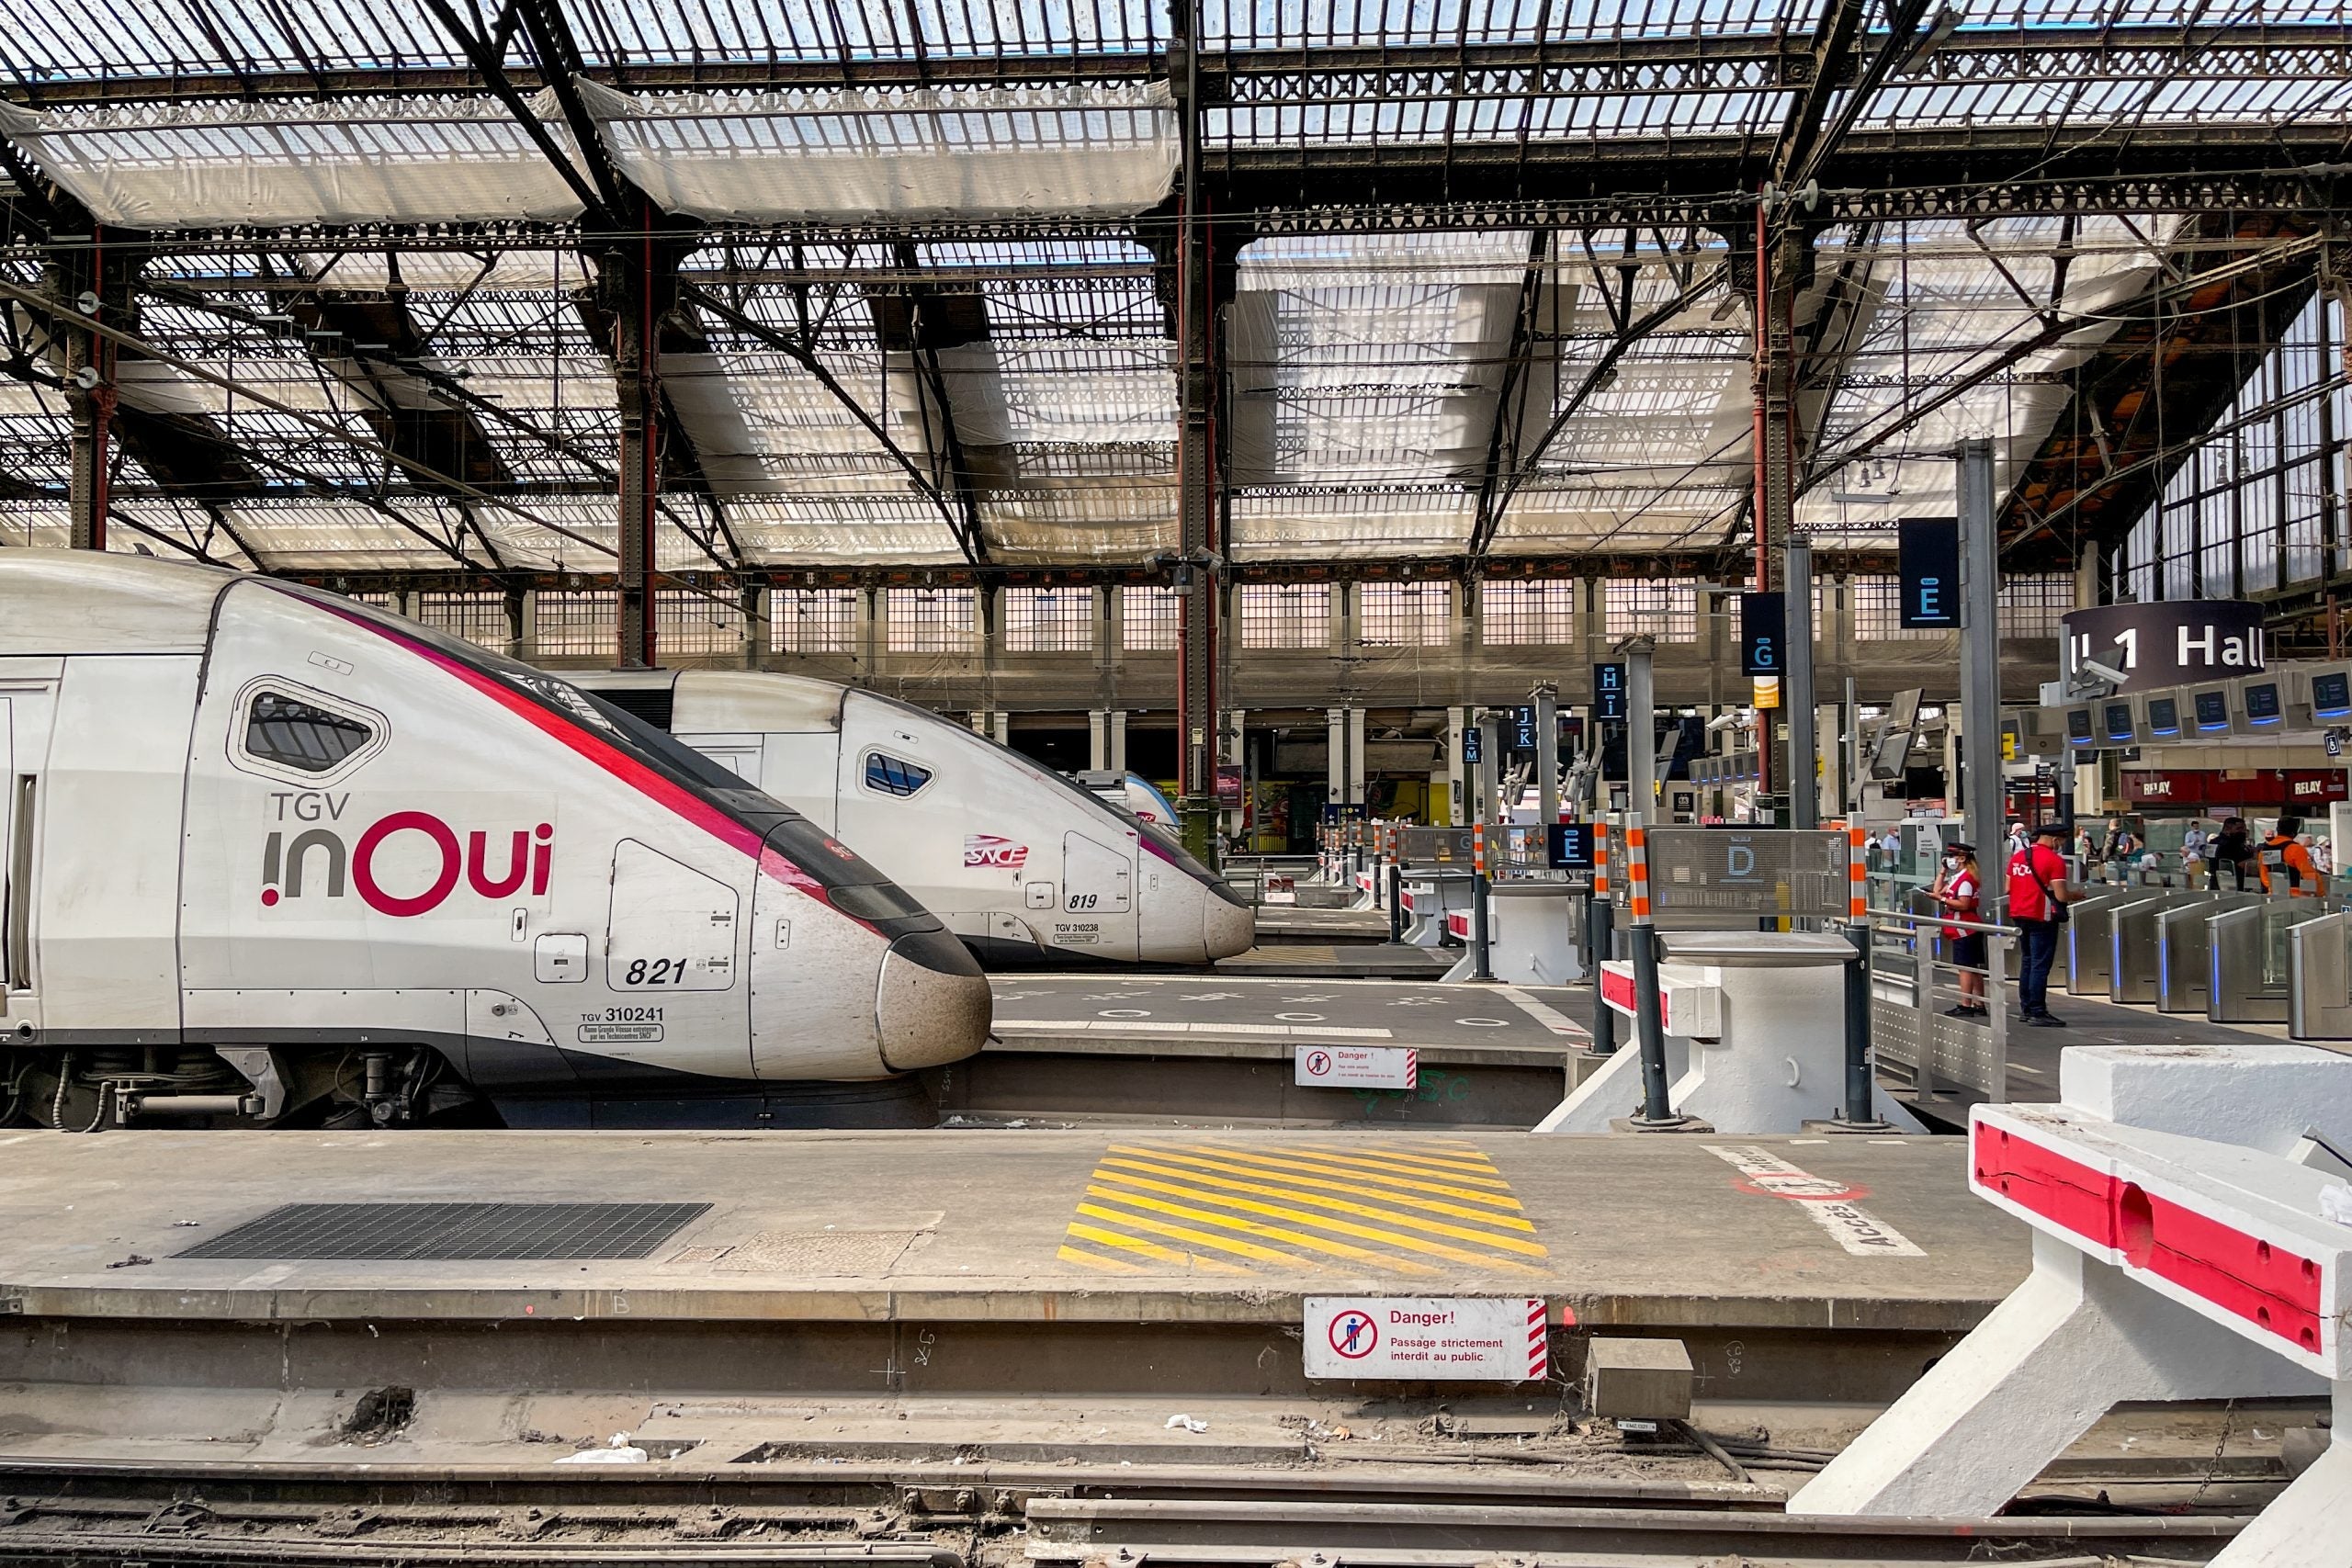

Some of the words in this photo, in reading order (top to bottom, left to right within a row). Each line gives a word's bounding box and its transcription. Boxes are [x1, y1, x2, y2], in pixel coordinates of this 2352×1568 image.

[1921, 589, 1939, 615] E
[2113, 627, 2136, 669] 1
[2177, 626, 2265, 669] Hall
[1754, 646, 1772, 666] G
[1603, 672, 1616, 688] H
[1520, 711, 1528, 724] J
[1468, 733, 1476, 743] L
[1521, 732, 1530, 745] K
[1466, 750, 1477, 760] M
[271, 792, 351, 821] TGV
[1565, 838, 1579, 858] E
[967, 848, 1027, 864] SNCF
[1728, 846, 1754, 875] D
[1069, 894, 1098, 909] 819
[1055, 923, 1071, 932] TGV
[1072, 923, 1099, 932] 310238
[626, 958, 687, 986] 821
[581, 1013, 602, 1021] TGV
[605, 1007, 663, 1021] 310241
[1338, 1051, 1368, 1060] Danger
[1390, 1310, 1454, 1326] Danger!
[1390, 1337, 1436, 1348] Passage
[1441, 1338, 1503, 1348] strictement
[1390, 1351, 1429, 1360] interdit
